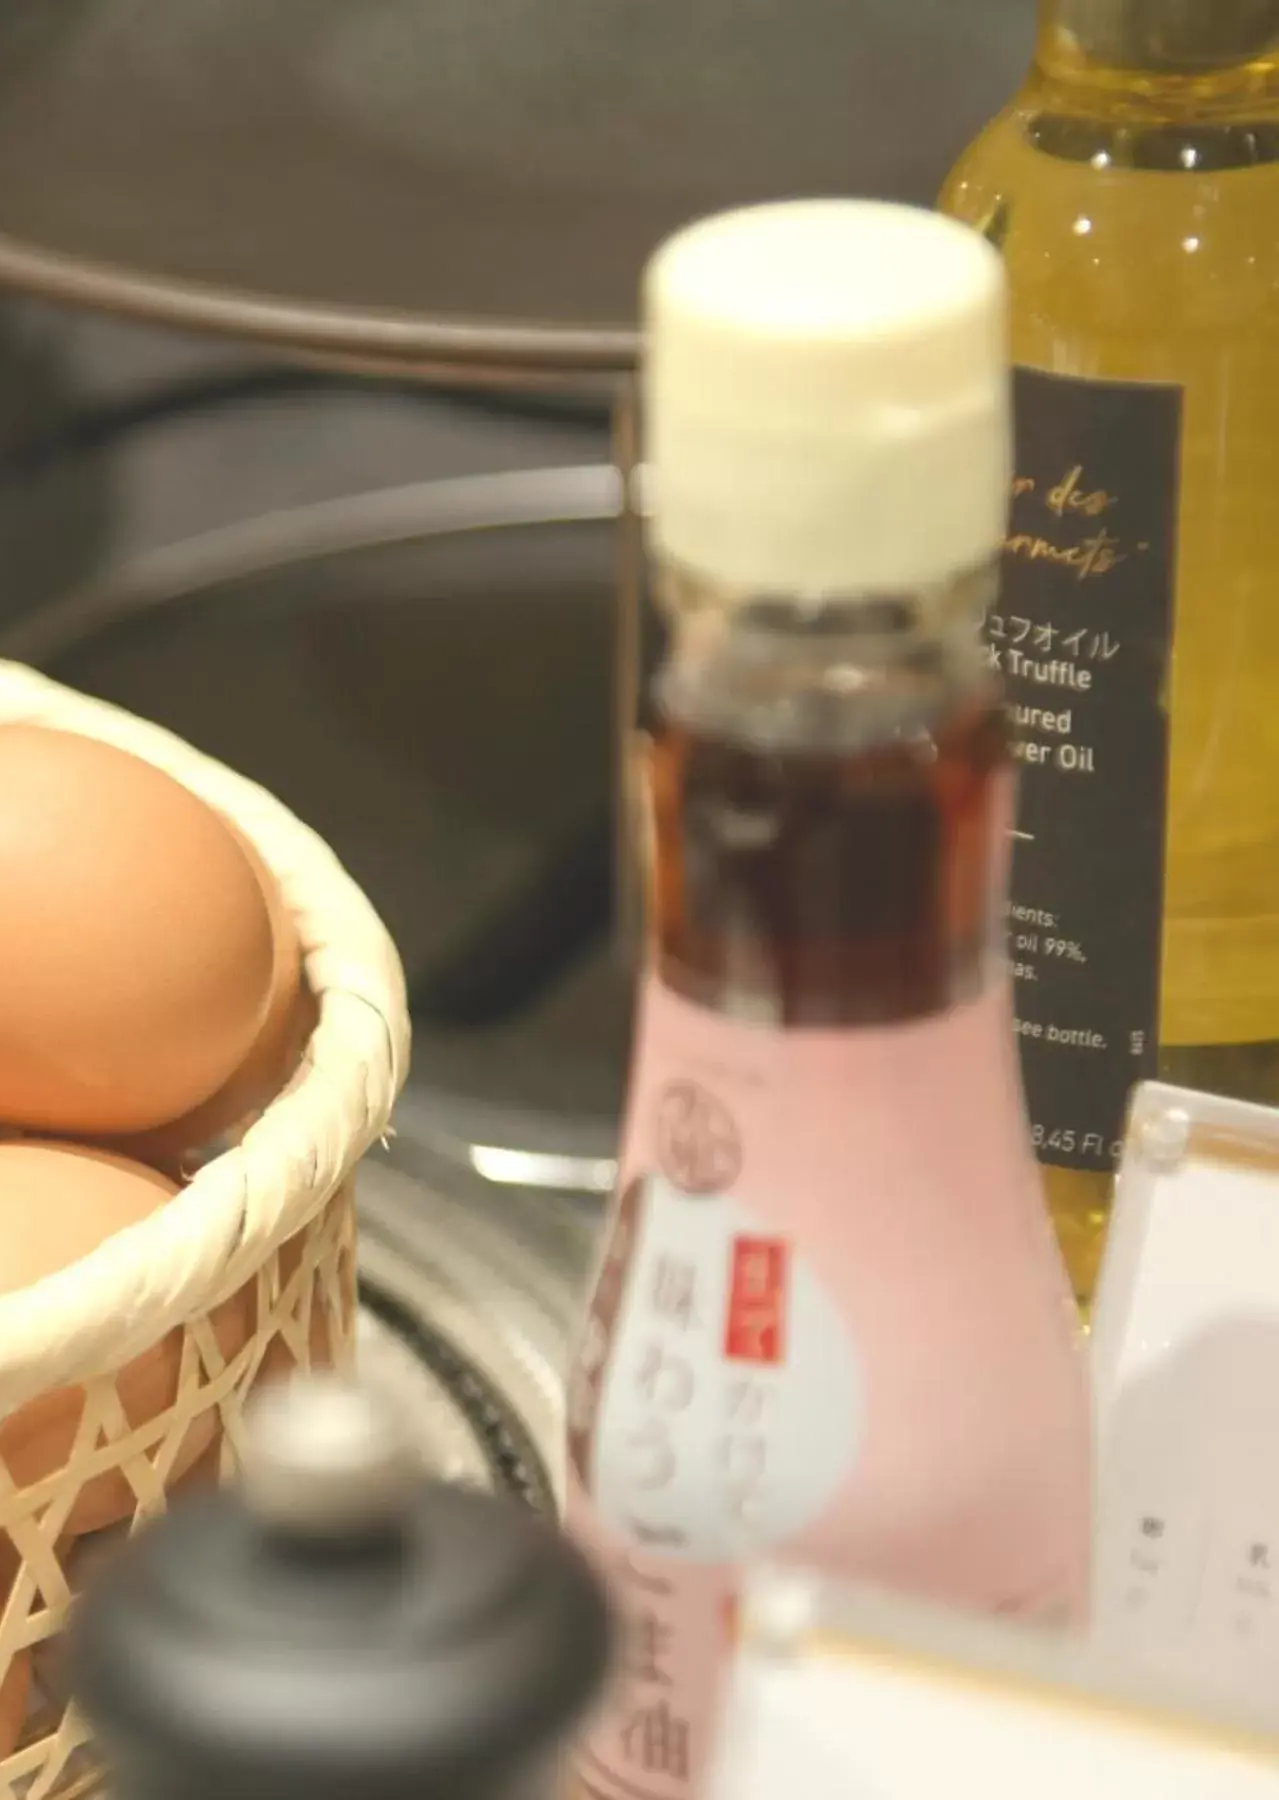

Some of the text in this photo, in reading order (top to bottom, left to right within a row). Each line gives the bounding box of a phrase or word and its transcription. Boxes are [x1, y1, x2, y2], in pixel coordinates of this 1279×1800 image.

[1008, 648, 1093, 690] Truffle
[1013, 704, 1073, 735] ured
[1059, 743, 1095, 773] Oil
[1046, 1024, 1108, 1050] bottle.
